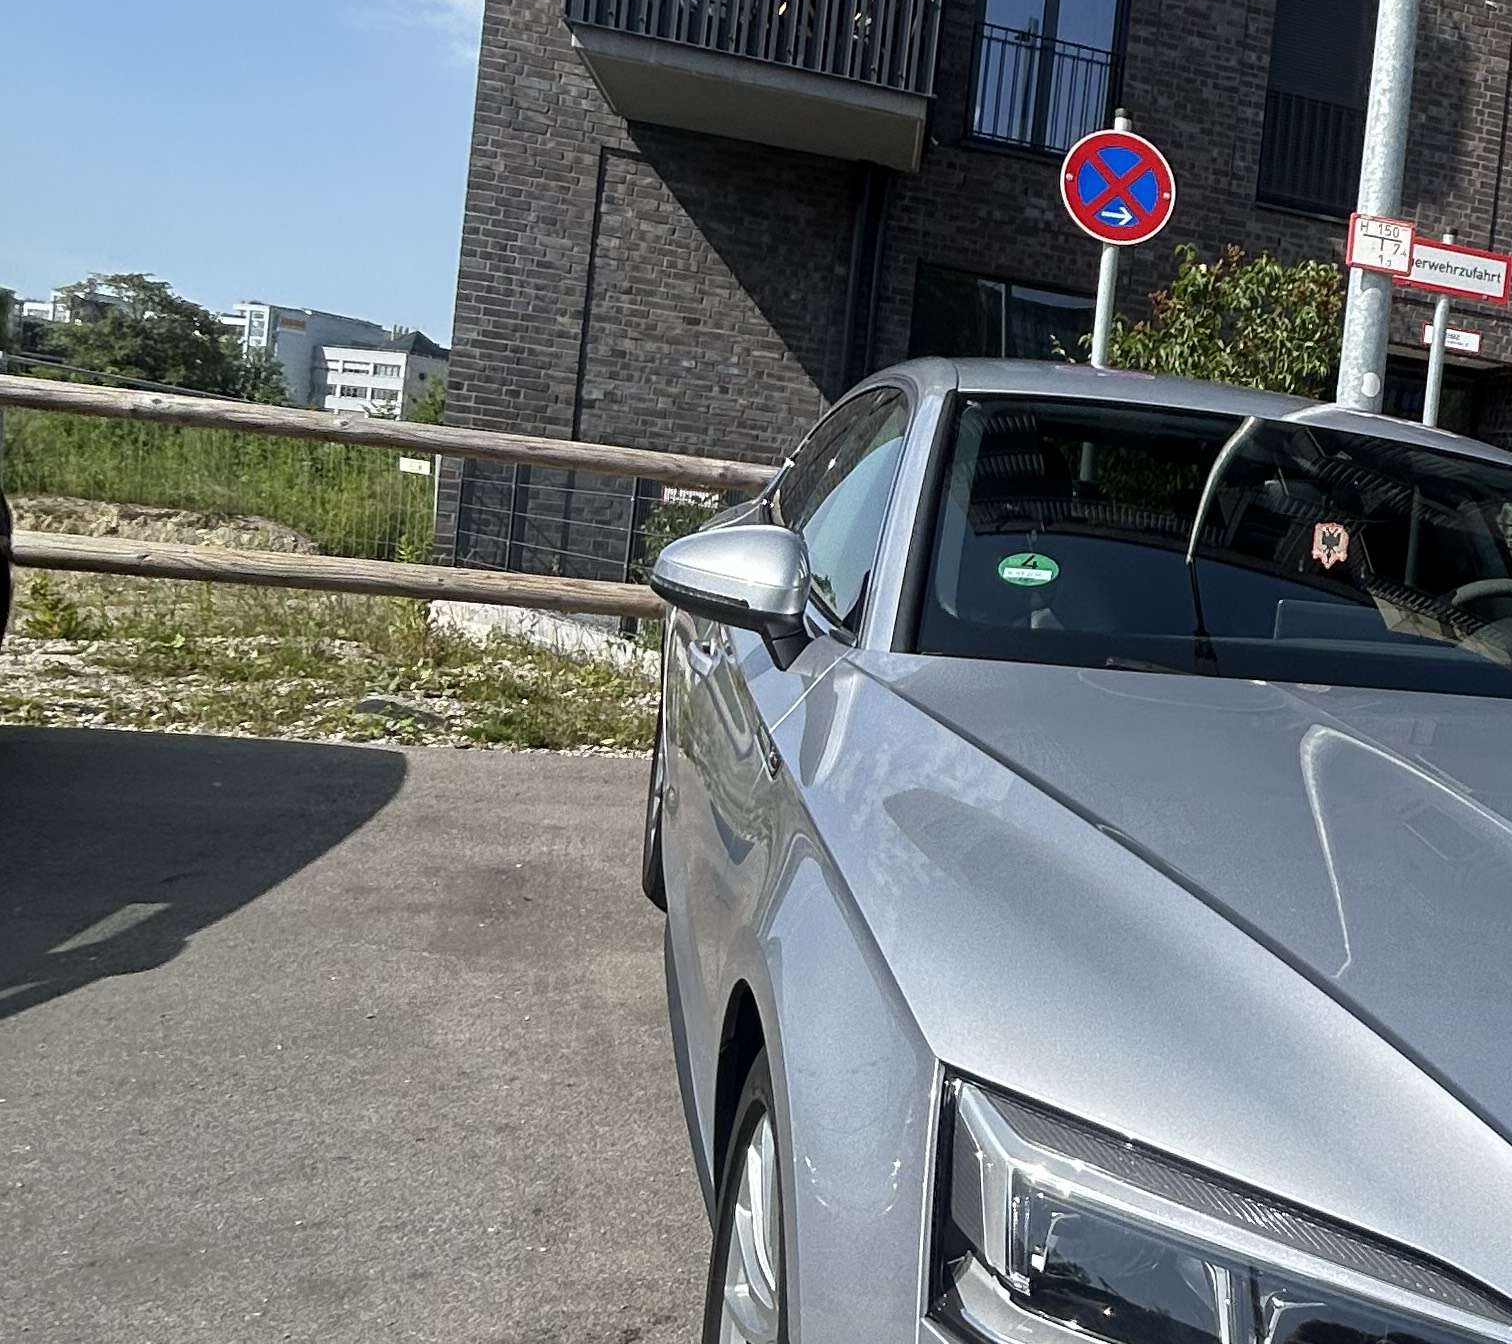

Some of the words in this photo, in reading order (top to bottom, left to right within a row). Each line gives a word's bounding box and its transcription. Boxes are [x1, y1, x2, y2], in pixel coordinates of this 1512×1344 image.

[1360, 220, 1369, 233] H
[1378, 223, 1400, 238] 150
[1411, 258, 1502, 283] erwehrzufahrt
[1021, 555, 1039, 569] 4
